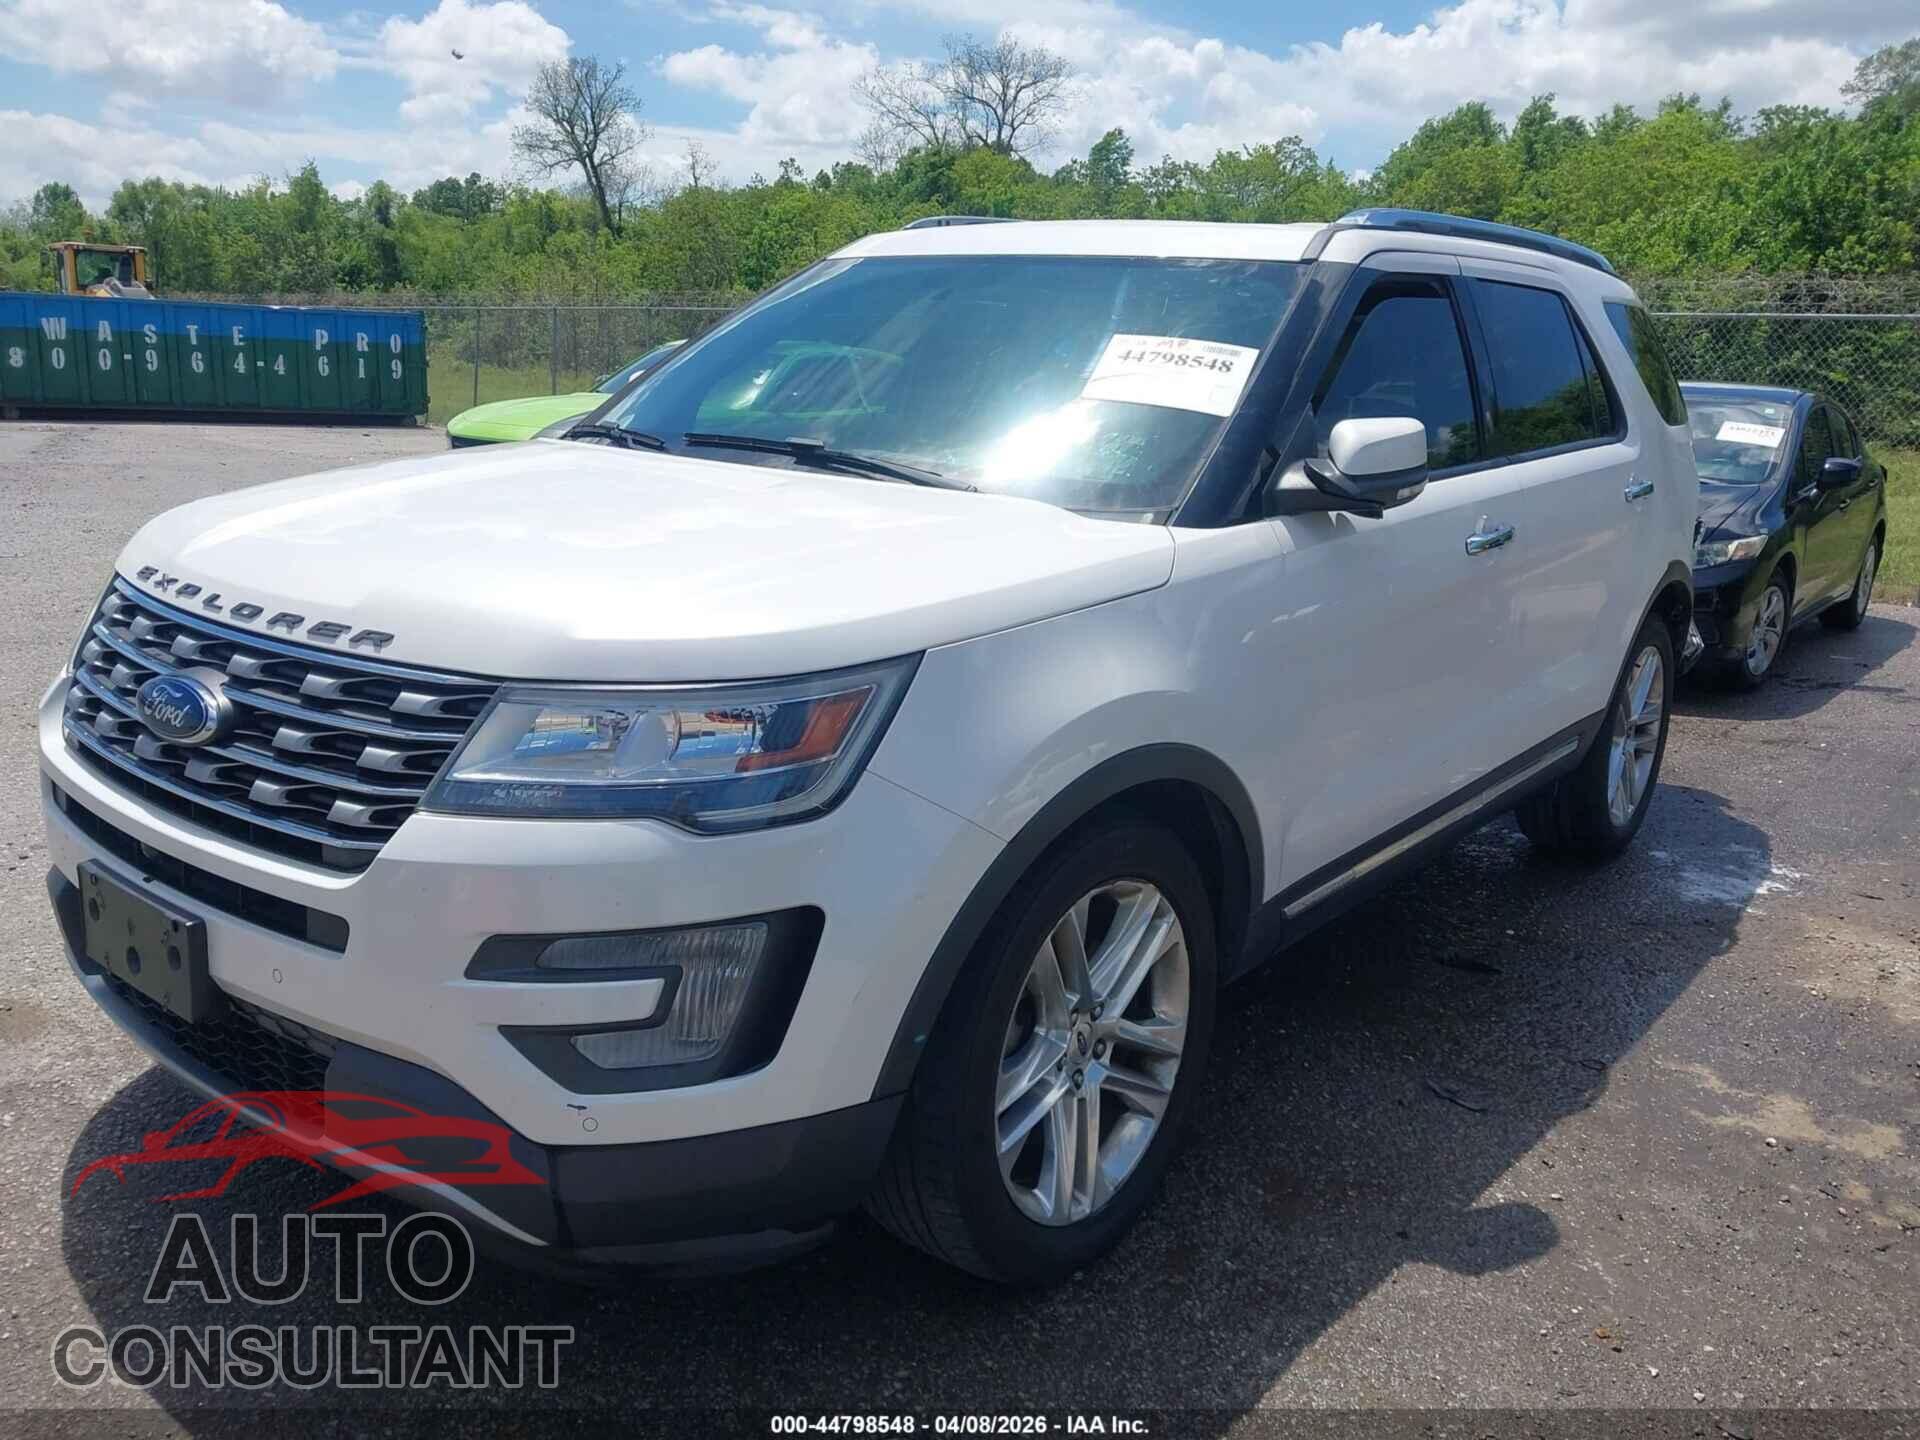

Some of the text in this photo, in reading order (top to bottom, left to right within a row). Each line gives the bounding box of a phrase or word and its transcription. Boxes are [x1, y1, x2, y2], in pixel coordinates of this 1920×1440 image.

[41, 316, 245, 346] WASTE
[1117, 349, 1234, 374] 44798548
[136, 565, 395, 654] EXPLORER
[144, 684, 190, 728] Ford
